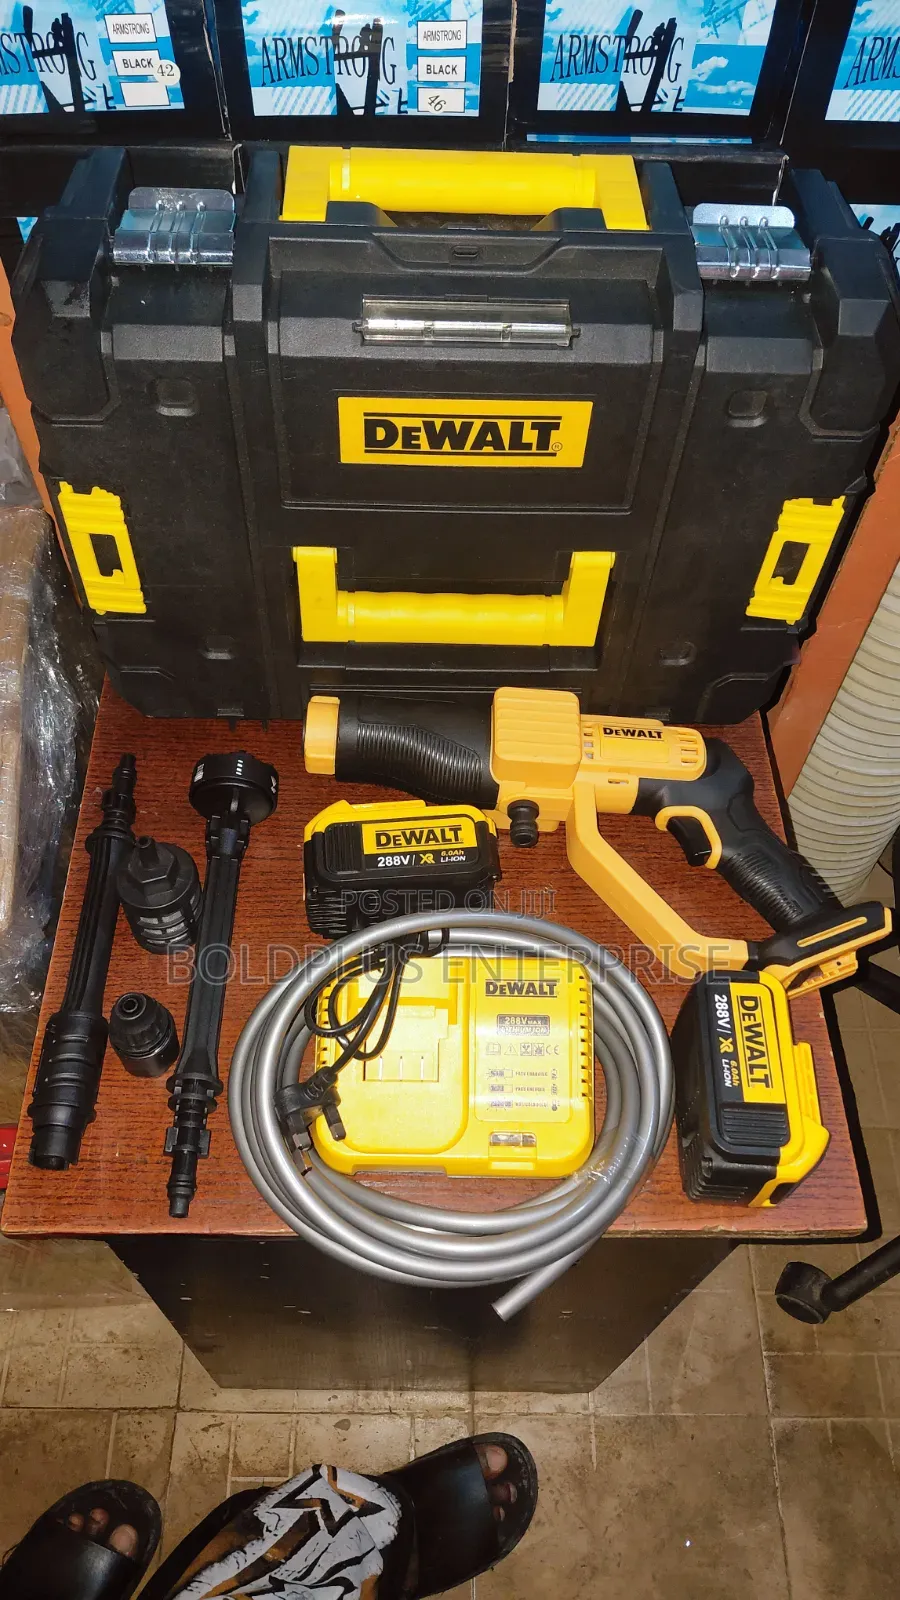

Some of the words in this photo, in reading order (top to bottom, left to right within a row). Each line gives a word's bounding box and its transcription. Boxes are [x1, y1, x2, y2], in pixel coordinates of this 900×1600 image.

[112, 22, 150, 36] ARMSTRONG
[422, 29, 462, 42] ARMSTRONG
[0, 32, 97, 81] STROG
[122, 57, 154, 69] BLACK
[261, 35, 397, 87] ARMSTROG
[549, 33, 685, 83] ARMSTROG
[156, 64, 175, 77] 42
[426, 64, 458, 75] BLACK
[427, 94, 447, 112] 46
[419, 853, 436, 864] XR
[719, 1036, 734, 1053] XR
[722, 1058, 733, 1087] LI-ION
